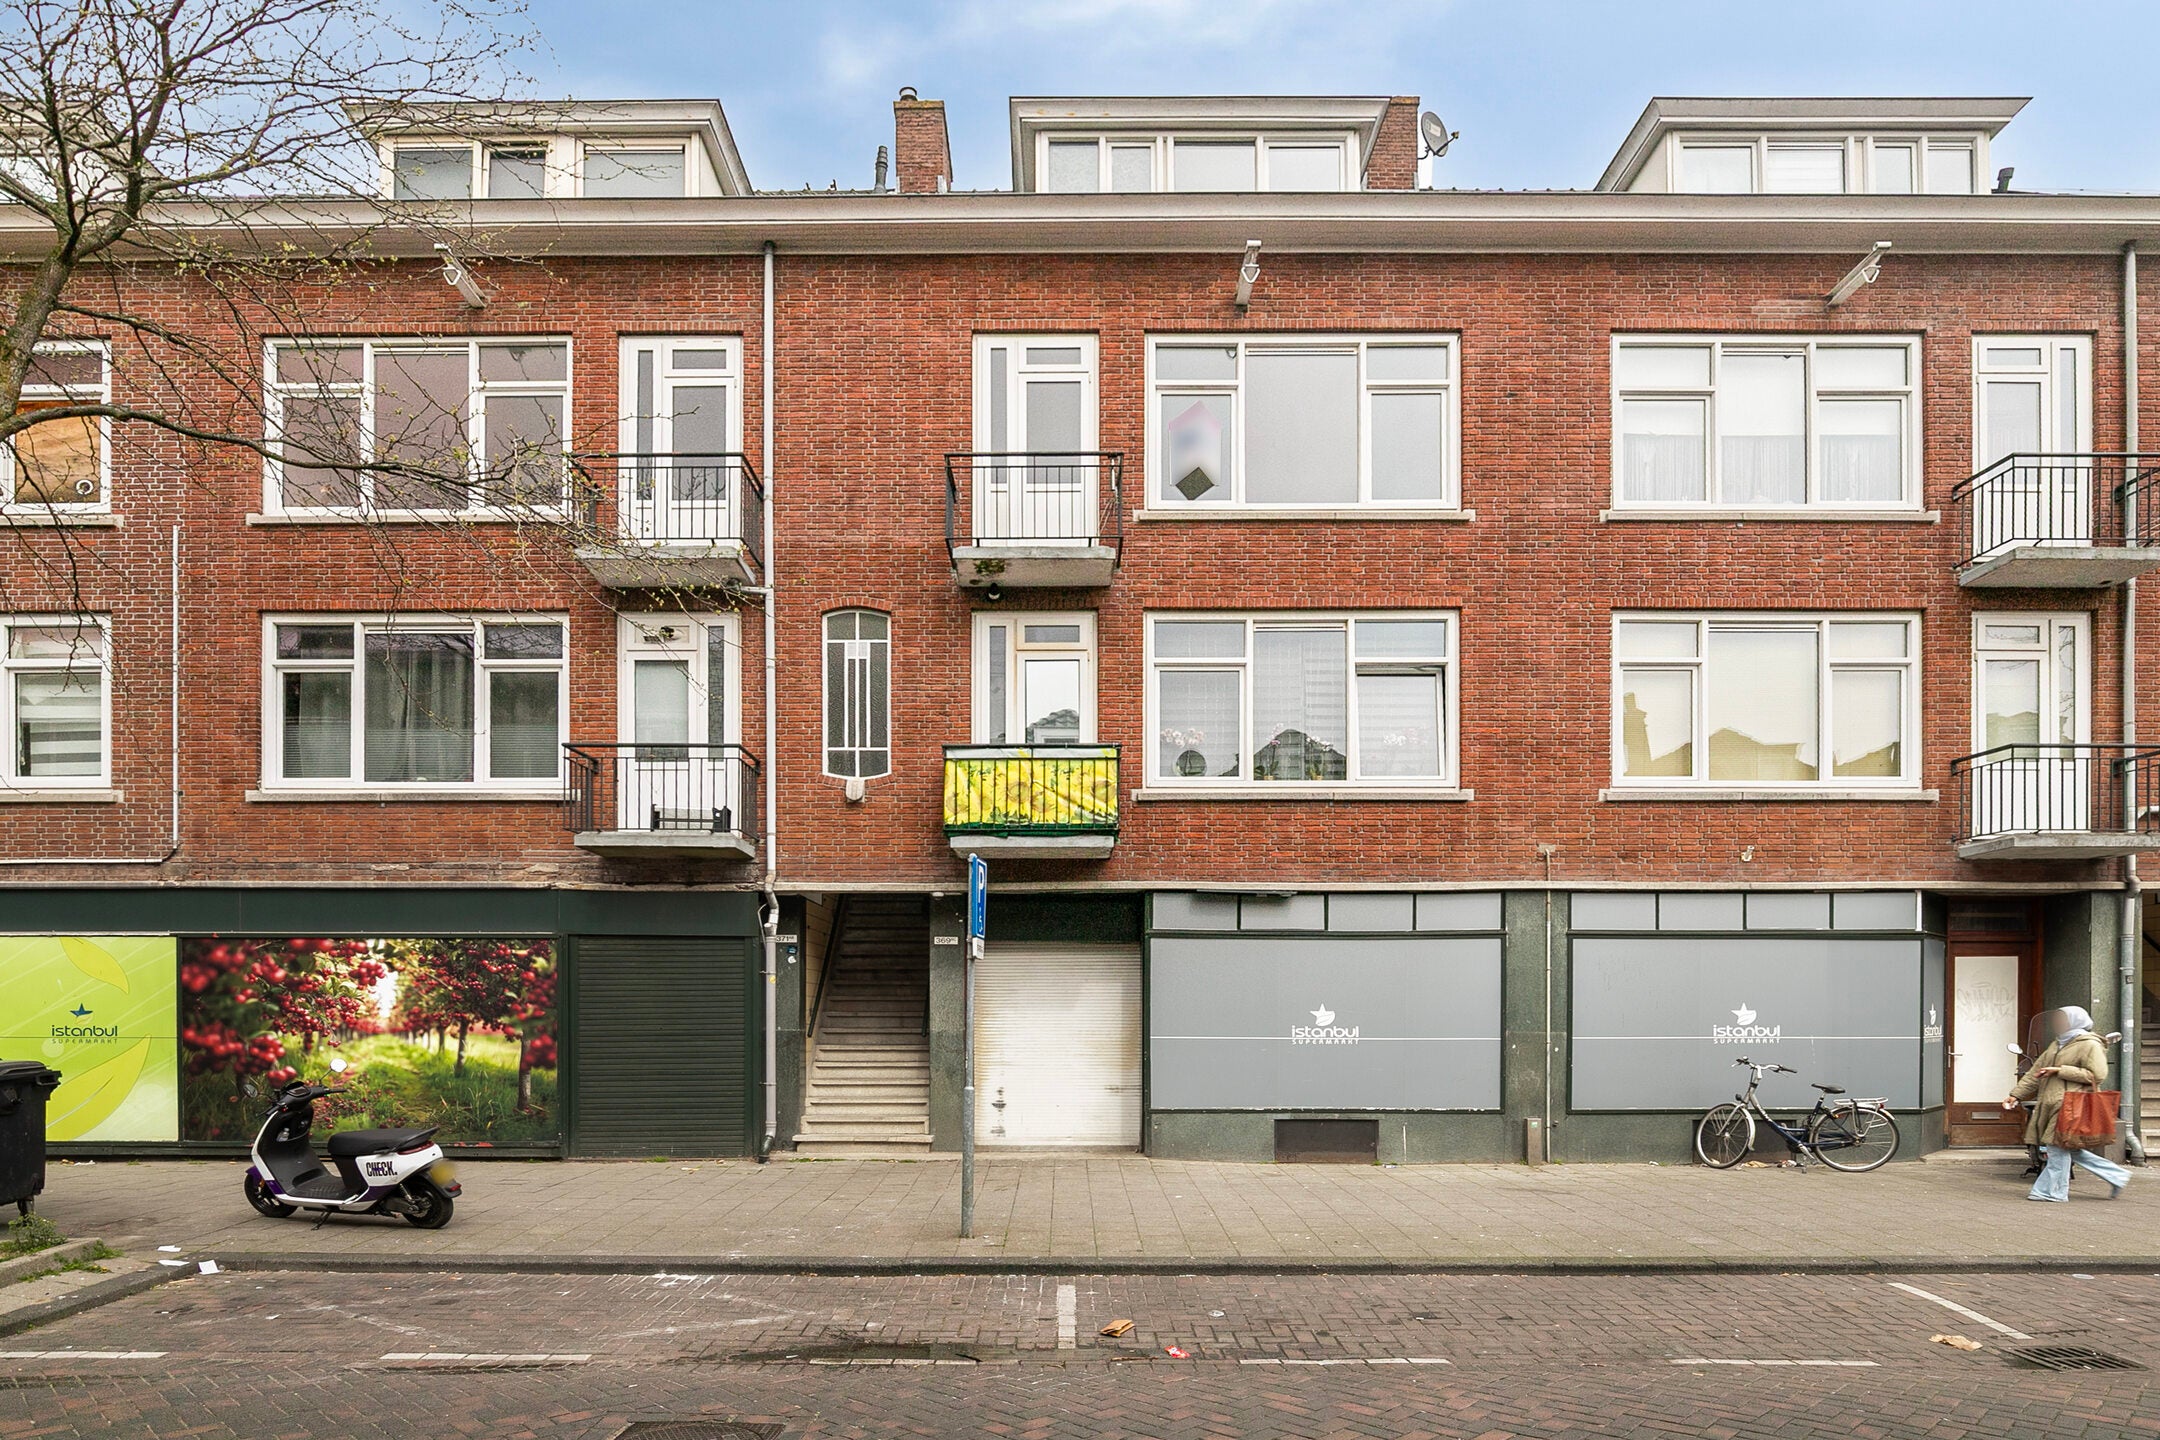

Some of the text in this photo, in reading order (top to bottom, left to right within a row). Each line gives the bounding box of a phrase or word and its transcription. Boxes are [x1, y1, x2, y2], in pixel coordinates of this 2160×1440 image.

[51, 1025, 118, 1036] istanbul
[1291, 1025, 1359, 1037] istanbul
[1713, 1024, 1780, 1036] istanbul
